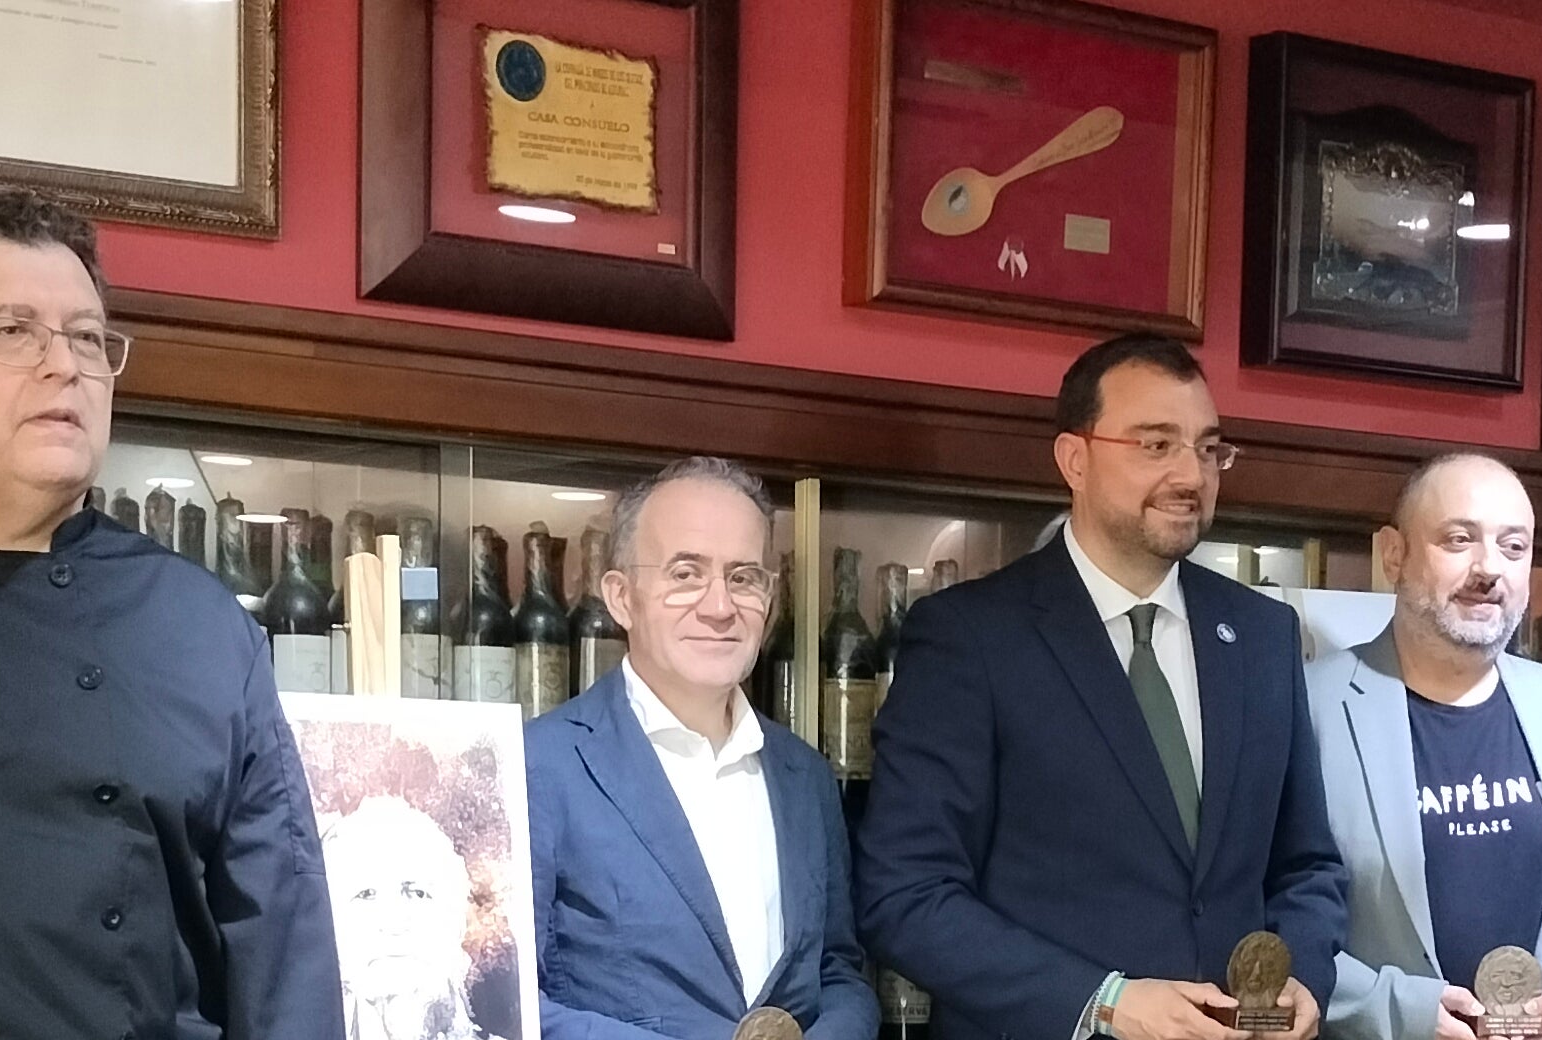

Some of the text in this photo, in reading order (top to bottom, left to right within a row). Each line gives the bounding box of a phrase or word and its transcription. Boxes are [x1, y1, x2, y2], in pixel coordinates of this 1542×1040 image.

[528, 111, 630, 133] CASA CONSUELO
[1448, 818, 1512, 836] PLEASE
